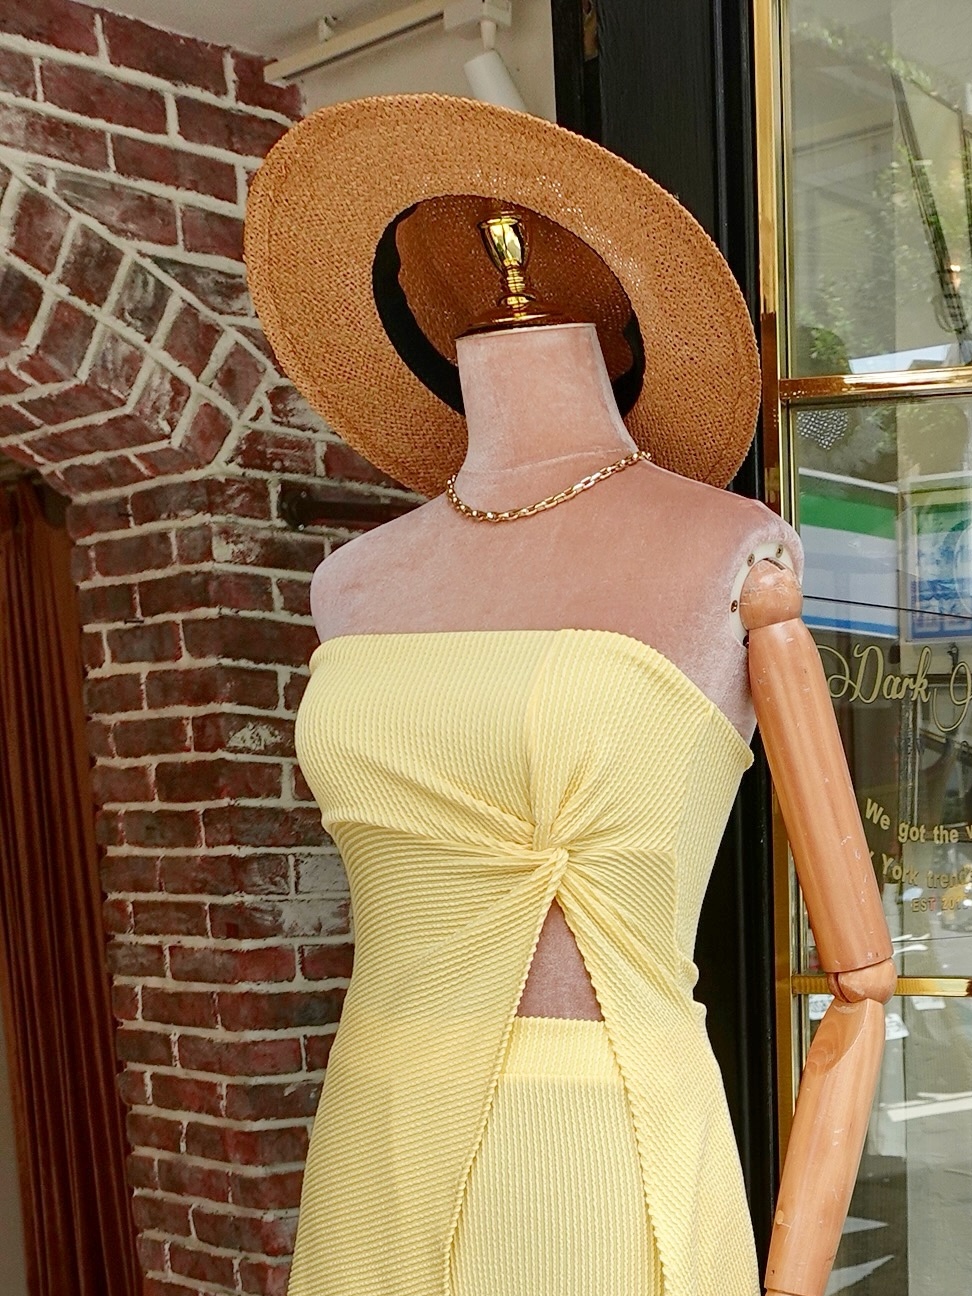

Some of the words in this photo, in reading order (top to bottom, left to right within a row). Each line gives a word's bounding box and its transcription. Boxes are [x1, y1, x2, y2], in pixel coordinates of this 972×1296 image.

[817, 643, 931, 704] Dark
[865, 798, 891, 830] We
[898, 820, 926, 843] got
[933, 825, 959, 844] the
[881, 852, 919, 886] York
[911, 897, 937, 913] EST
